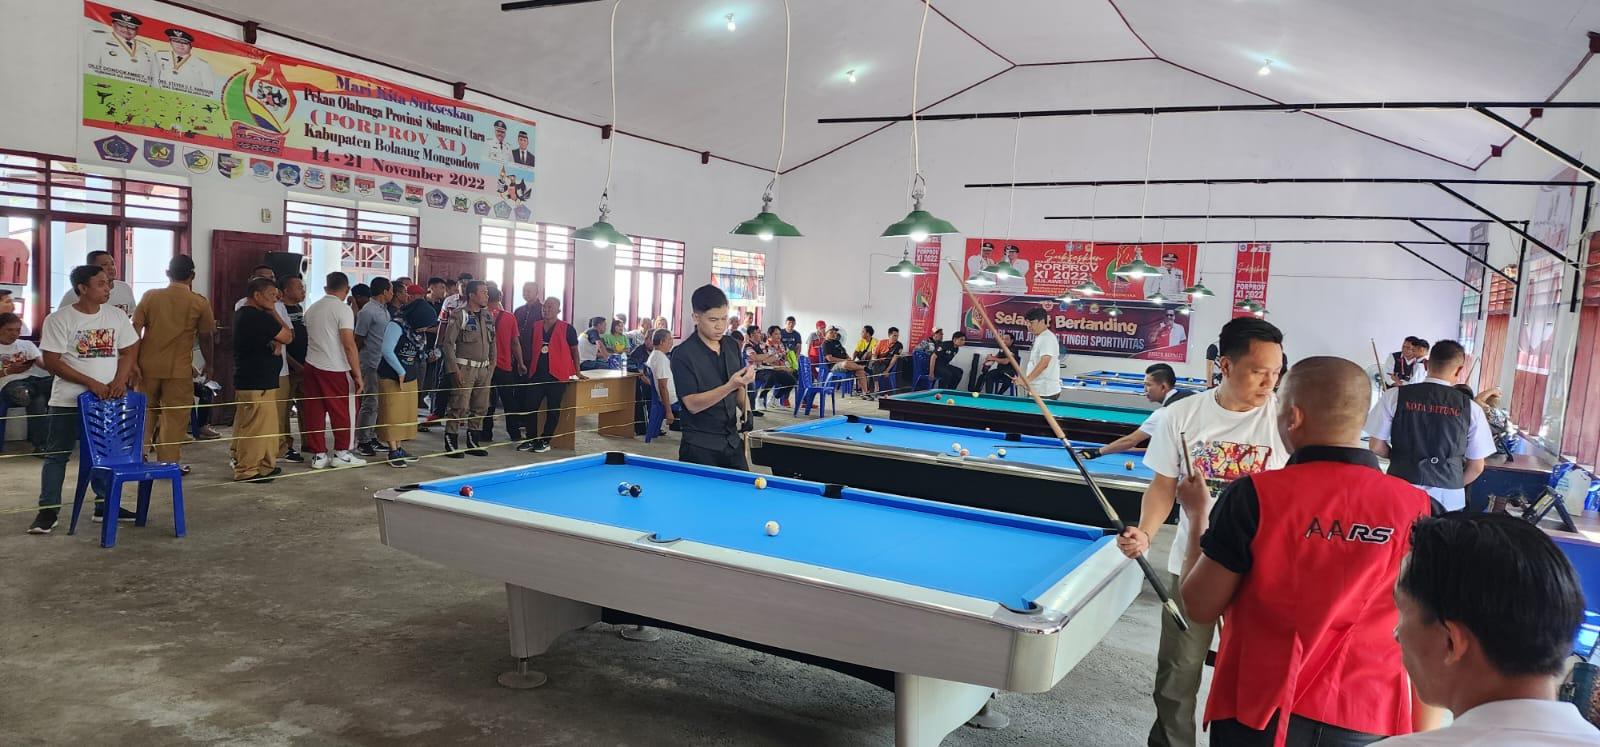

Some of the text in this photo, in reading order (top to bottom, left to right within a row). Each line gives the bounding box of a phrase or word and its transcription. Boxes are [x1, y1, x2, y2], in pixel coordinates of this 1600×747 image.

[336, 75, 474, 122] Mari Kita Sukseskan
[304, 88, 485, 142] Pekan Olahraga Provinsi Sulawesi Utara
[304, 123, 371, 149] Kabupaten
[375, 138, 420, 160] Bolaang
[423, 148, 481, 171] Mongondow
[372, 157, 443, 183] November
[449, 172, 485, 190] 2022
[1034, 263, 1099, 273] PORPROV
[1034, 270, 1088, 280] XI 2022
[1055, 314, 1138, 335] Bertanding
[1062, 334, 1089, 346] TINGGI
[1090, 336, 1145, 350] SPORTIVITAS
[1406, 401, 1426, 412] KOTA
